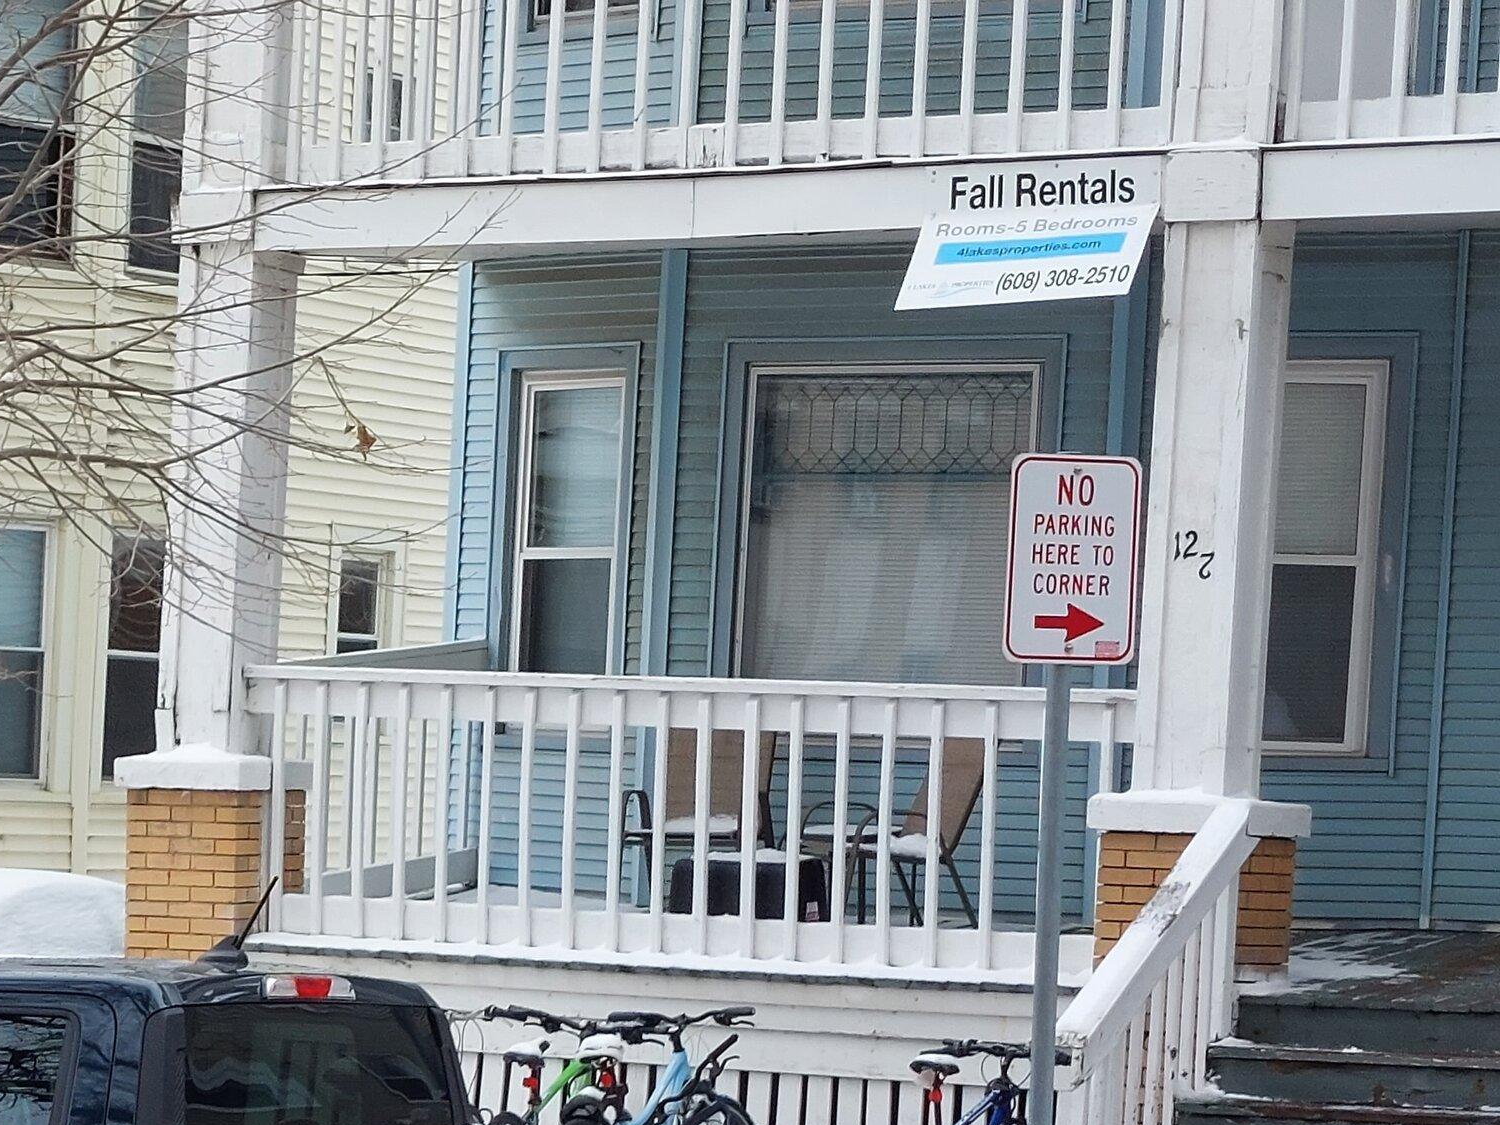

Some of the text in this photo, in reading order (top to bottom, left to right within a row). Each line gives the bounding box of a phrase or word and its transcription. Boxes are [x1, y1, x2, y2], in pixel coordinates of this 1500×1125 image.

[950, 169, 1135, 210] Fall Rentals
[936, 216, 1138, 237] Rooms-5 Bedrooms
[956, 239, 1101, 257] 4lakesproperties.com
[996, 265, 1130, 295] (608) 308-2510
[1057, 475, 1095, 506] NO
[1033, 514, 1115, 537] PARKING
[1032, 543, 1114, 566] HERE TO
[1033, 573, 1111, 596] CORNER
